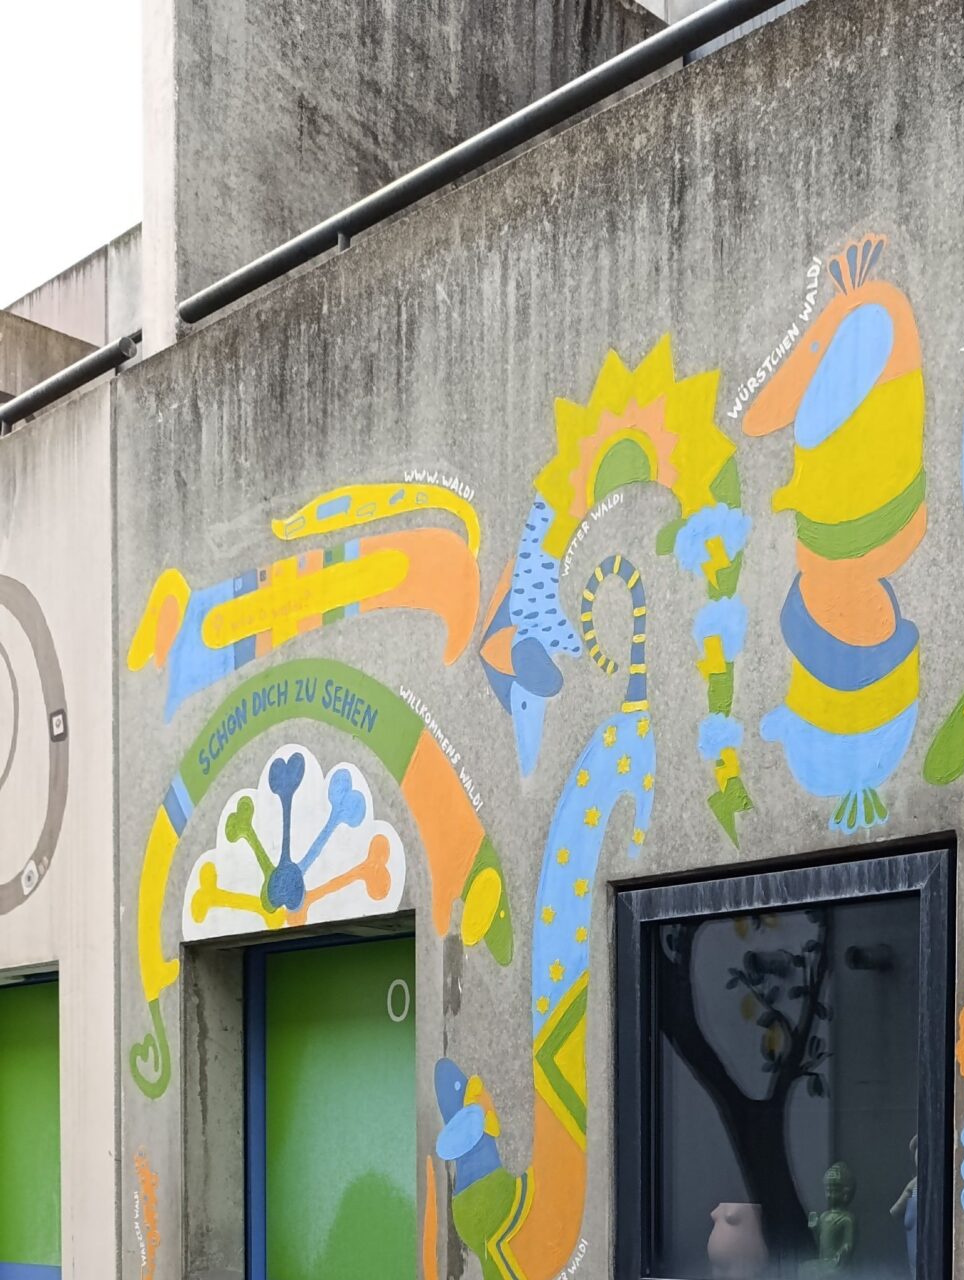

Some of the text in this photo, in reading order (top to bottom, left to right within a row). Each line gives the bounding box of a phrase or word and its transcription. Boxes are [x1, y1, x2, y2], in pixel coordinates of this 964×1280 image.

[726, 255, 823, 420] WÜRSTCHEN WALDI
[561, 493, 624, 577] WETTER WALDI
[251, 679, 289, 717] DICH
[294, 677, 318, 704] ZU
[321, 679, 379, 733] SEHEN
[399, 685, 484, 813] WILLKOMMENS WALDI
[567, 1238, 589, 1275] WALDI
